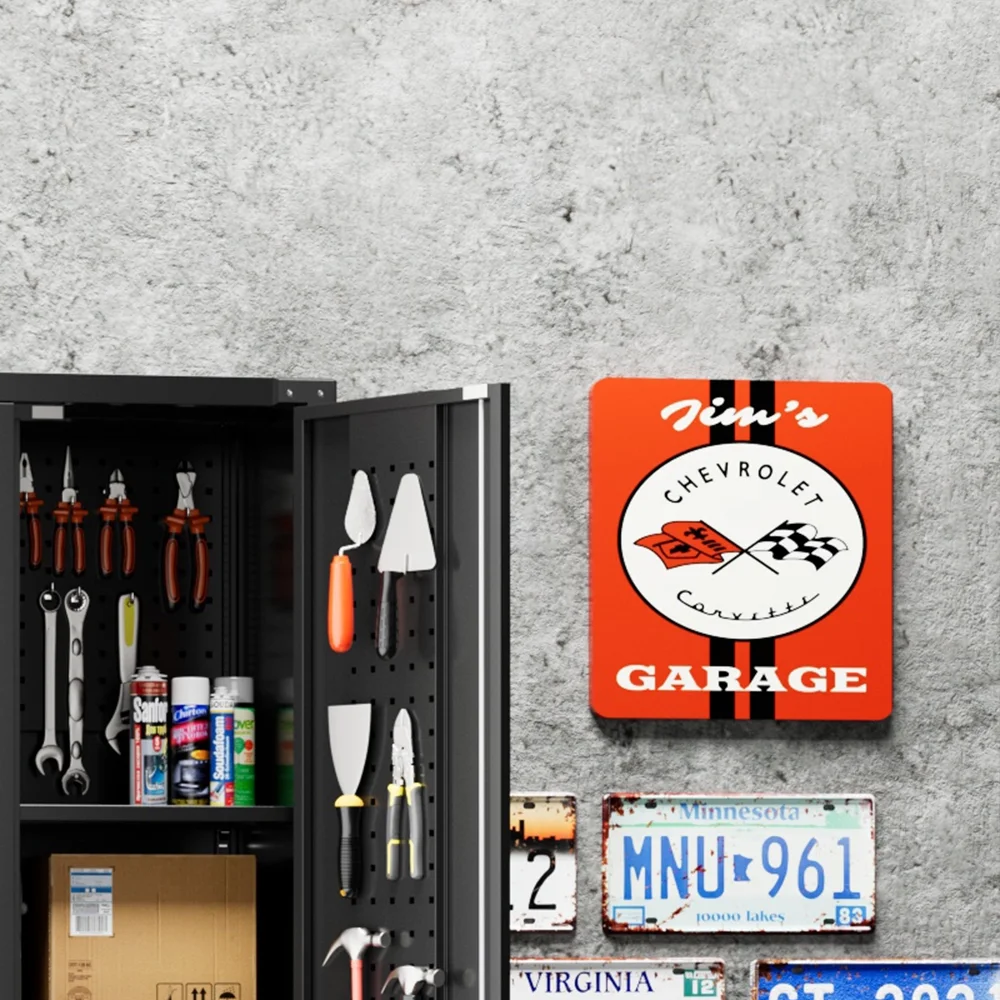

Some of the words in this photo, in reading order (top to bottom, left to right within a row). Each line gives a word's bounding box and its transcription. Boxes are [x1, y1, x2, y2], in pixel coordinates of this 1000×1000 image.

[660, 397, 829, 431] Jim's
[664, 461, 823, 507] CHEVROLET
[677, 589, 820, 621] Corvette
[616, 665, 867, 692] GARAGE
[213, 716, 225, 780] Soudafoam
[679, 802, 800, 821] Minnesota
[622, 836, 725, 900] MNU
[762, 836, 860, 900] 961
[746, 910, 785, 922] lakes
[839, 907, 863, 924] 83
[525, 971, 654, 993] VIRGINIA
[692, 980, 713, 994] 12
